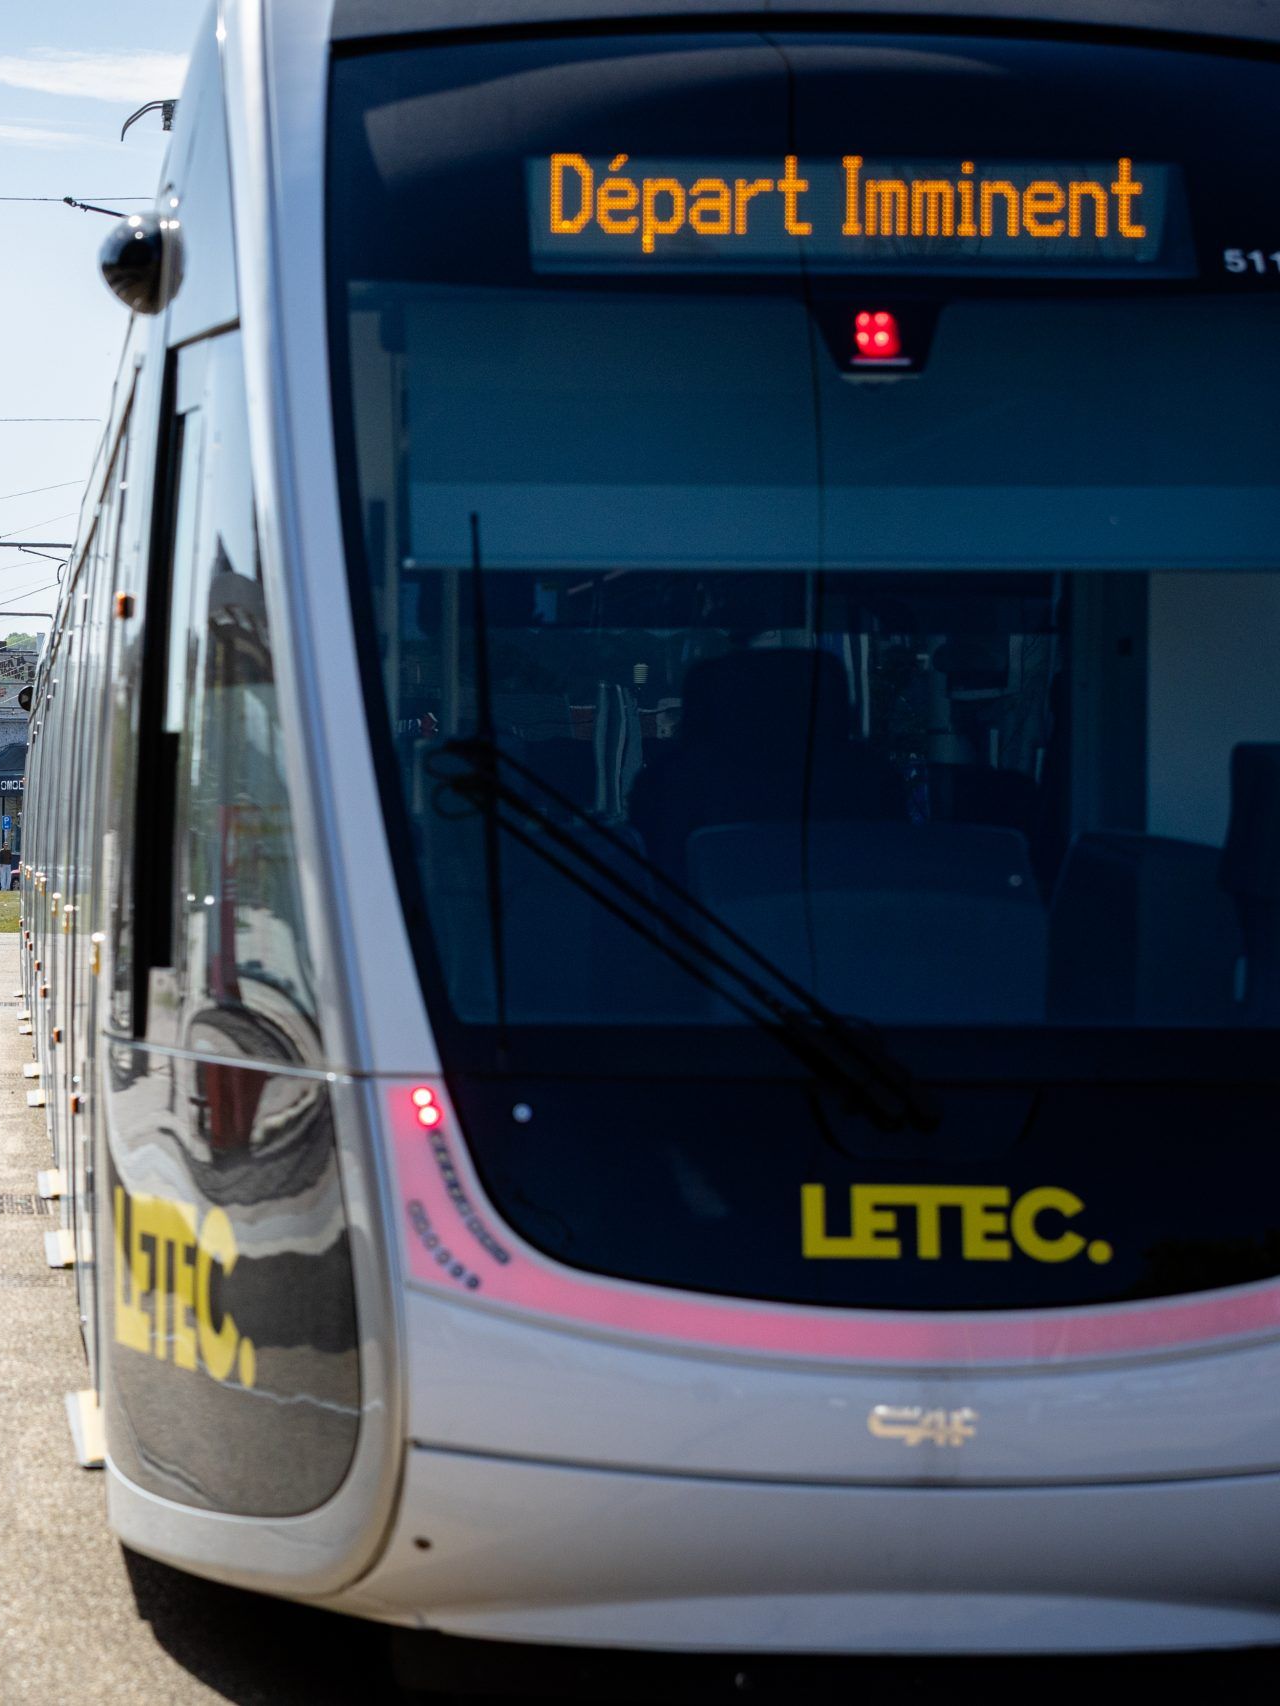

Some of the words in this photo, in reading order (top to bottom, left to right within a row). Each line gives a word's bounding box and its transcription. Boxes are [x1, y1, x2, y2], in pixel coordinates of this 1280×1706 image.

[550, 153, 812, 253] Départ
[842, 155, 1146, 238] Imminent
[801, 1183, 1113, 1264] LETEC.
